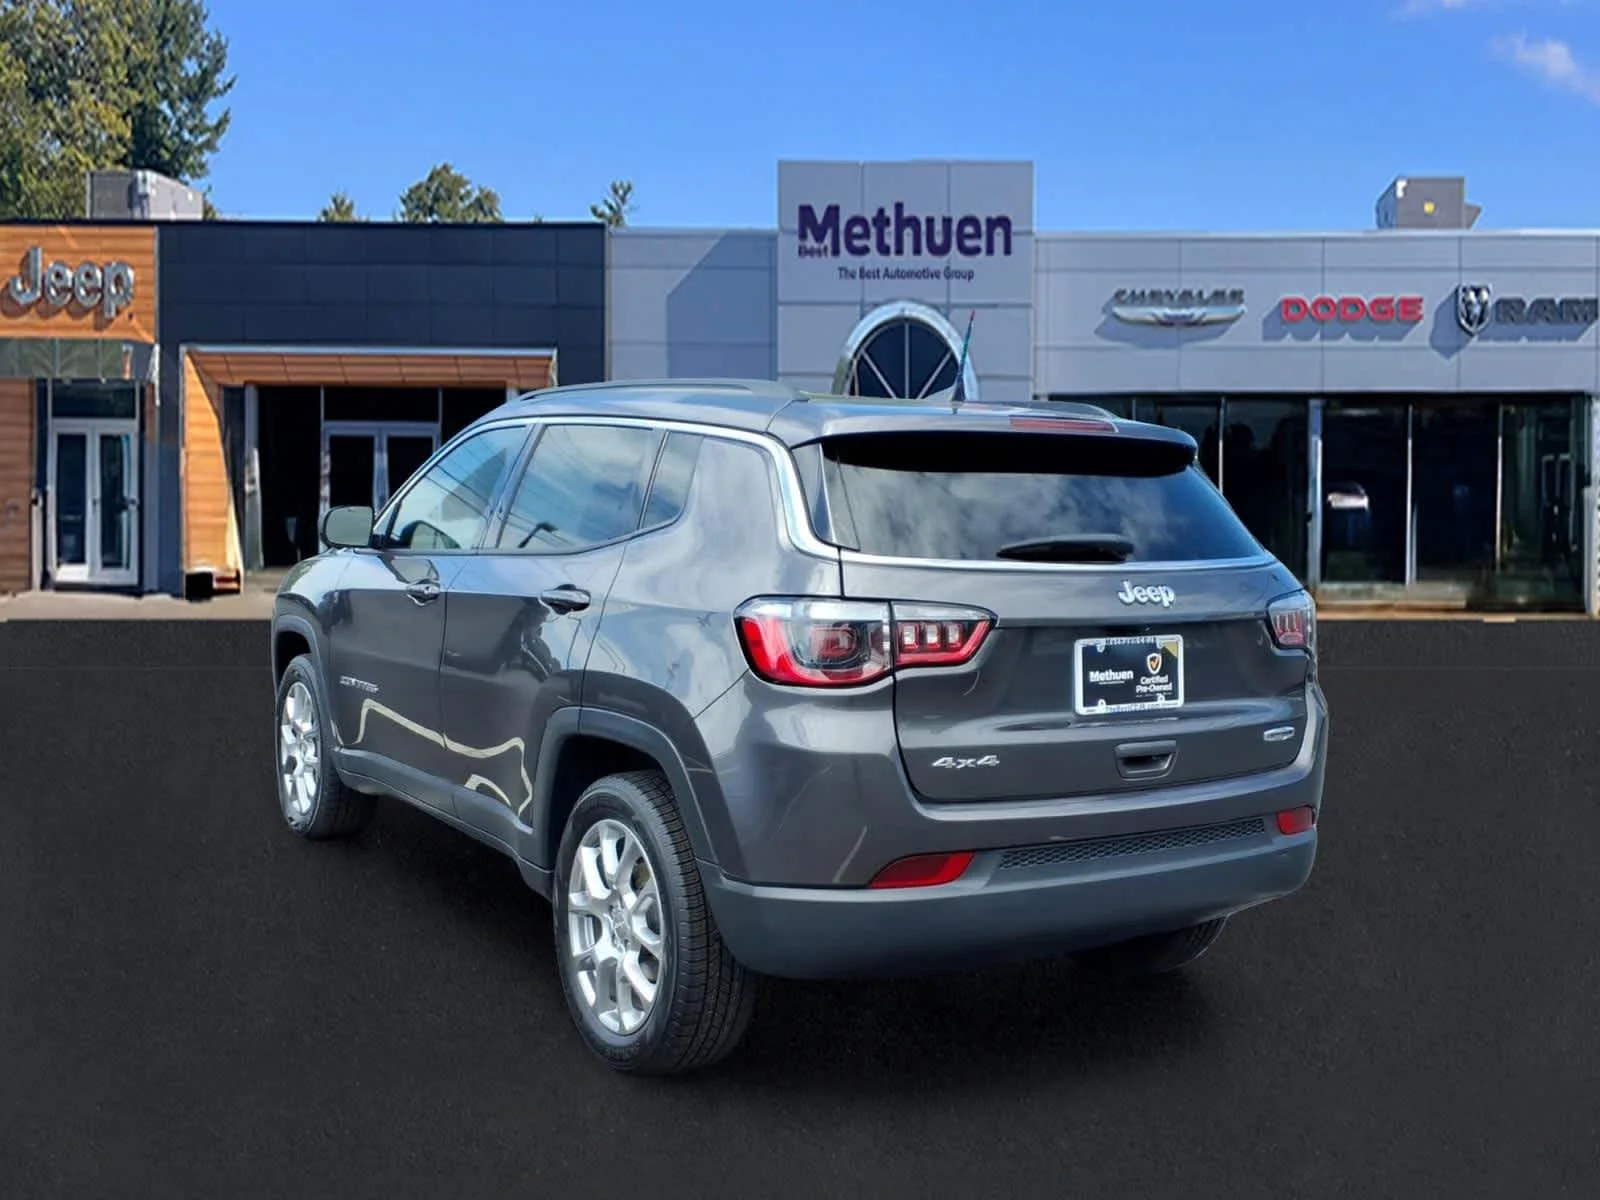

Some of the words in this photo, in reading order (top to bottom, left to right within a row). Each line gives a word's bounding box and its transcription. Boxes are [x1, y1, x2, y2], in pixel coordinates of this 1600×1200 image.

[798, 202, 1012, 256] Methuen
[9, 246, 135, 319] Jeep
[838, 266, 857, 280] The
[859, 266, 880, 280] Best
[882, 266, 941, 280] Automotive
[943, 266, 975, 282] Group
[1281, 296, 1424, 323] DODGE
[1496, 297, 1599, 324] RAM
[1118, 580, 1176, 608] Jeep
[1089, 669, 1133, 682] Methuen
[1140, 675, 1168, 684] Certified
[1136, 683, 1172, 693] Pre-Owned
[932, 755, 1000, 768] 4x4
